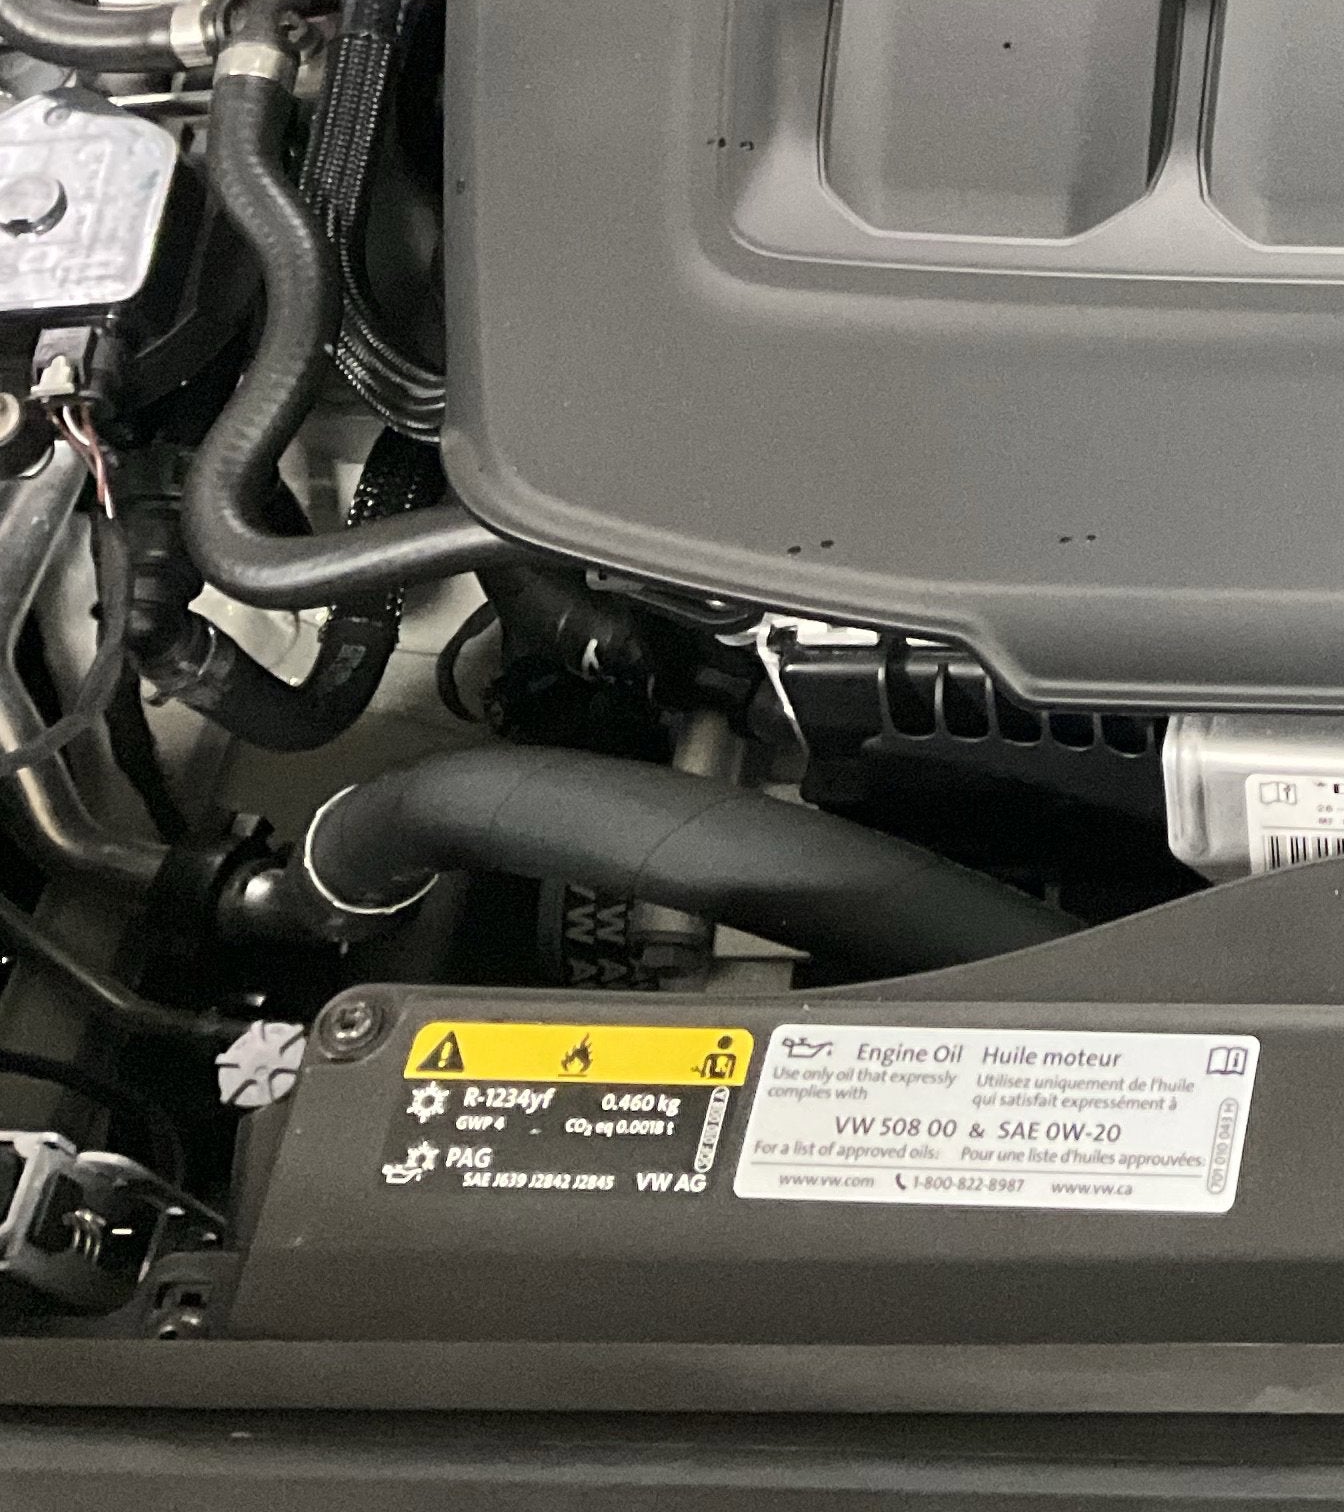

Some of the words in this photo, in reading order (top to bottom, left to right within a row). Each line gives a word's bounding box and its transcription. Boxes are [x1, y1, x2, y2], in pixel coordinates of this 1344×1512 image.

[857, 1043, 928, 1067] Engine
[933, 1045, 963, 1063] Oil
[982, 1047, 1037, 1065] Huile
[1043, 1049, 1121, 1067] moteur
[773, 1067, 799, 1080] Use
[802, 1068, 832, 1084] only
[836, 1069, 854, 1080] oil
[857, 1068, 887, 1082] that
[890, 1070, 957, 1088] expressly
[977, 1074, 1030, 1088] Utilisez
[1035, 1076, 1124, 1093] uniquement
[1129, 1078, 1146, 1092] de
[1150, 1078, 1195, 1093] l'huile
[464, 1087, 556, 1113] R-1234yf
[768, 1086, 831, 1102] complies
[835, 1087, 868, 1100] with
[972, 1092, 996, 1108] qui
[1000, 1092, 1057, 1108] satisfait
[1061, 1094, 1165, 1112] expressément
[1168, 1095, 1177, 1110] à
[602, 1093, 654, 1112] 0.460
[657, 1095, 681, 1117] kg
[456, 1116, 492, 1130] GWP
[596, 1121, 613, 1137] eq
[835, 1115, 874, 1135] VW
[879, 1117, 921, 1136] 508
[928, 1119, 957, 1137] 00
[969, 1123, 984, 1138] &
[998, 1122, 1040, 1139] SAE
[1046, 1122, 1122, 1142] 0W-20
[446, 1148, 492, 1168] PAG
[753, 1141, 778, 1154] For
[781, 1145, 789, 1154] a
[794, 1142, 815, 1156] list
[818, 1142, 835, 1156] of
[837, 1144, 906, 1160] approved
[910, 1145, 939, 1159] oils:
[961, 1147, 994, 1161] Pour
[997, 1150, 1024, 1162] une
[1028, 1148, 1057, 1163] liste
[1061, 1149, 1115, 1165] d'huiles
[463, 1173, 490, 1187] SAE
[636, 1173, 670, 1192] VW
[673, 1174, 707, 1192] AG
[779, 1176, 874, 1187] www.vw.com
[914, 1175, 1024, 1193] 1-800-822-8987
[1051, 1182, 1133, 1195] www.vw.ca
